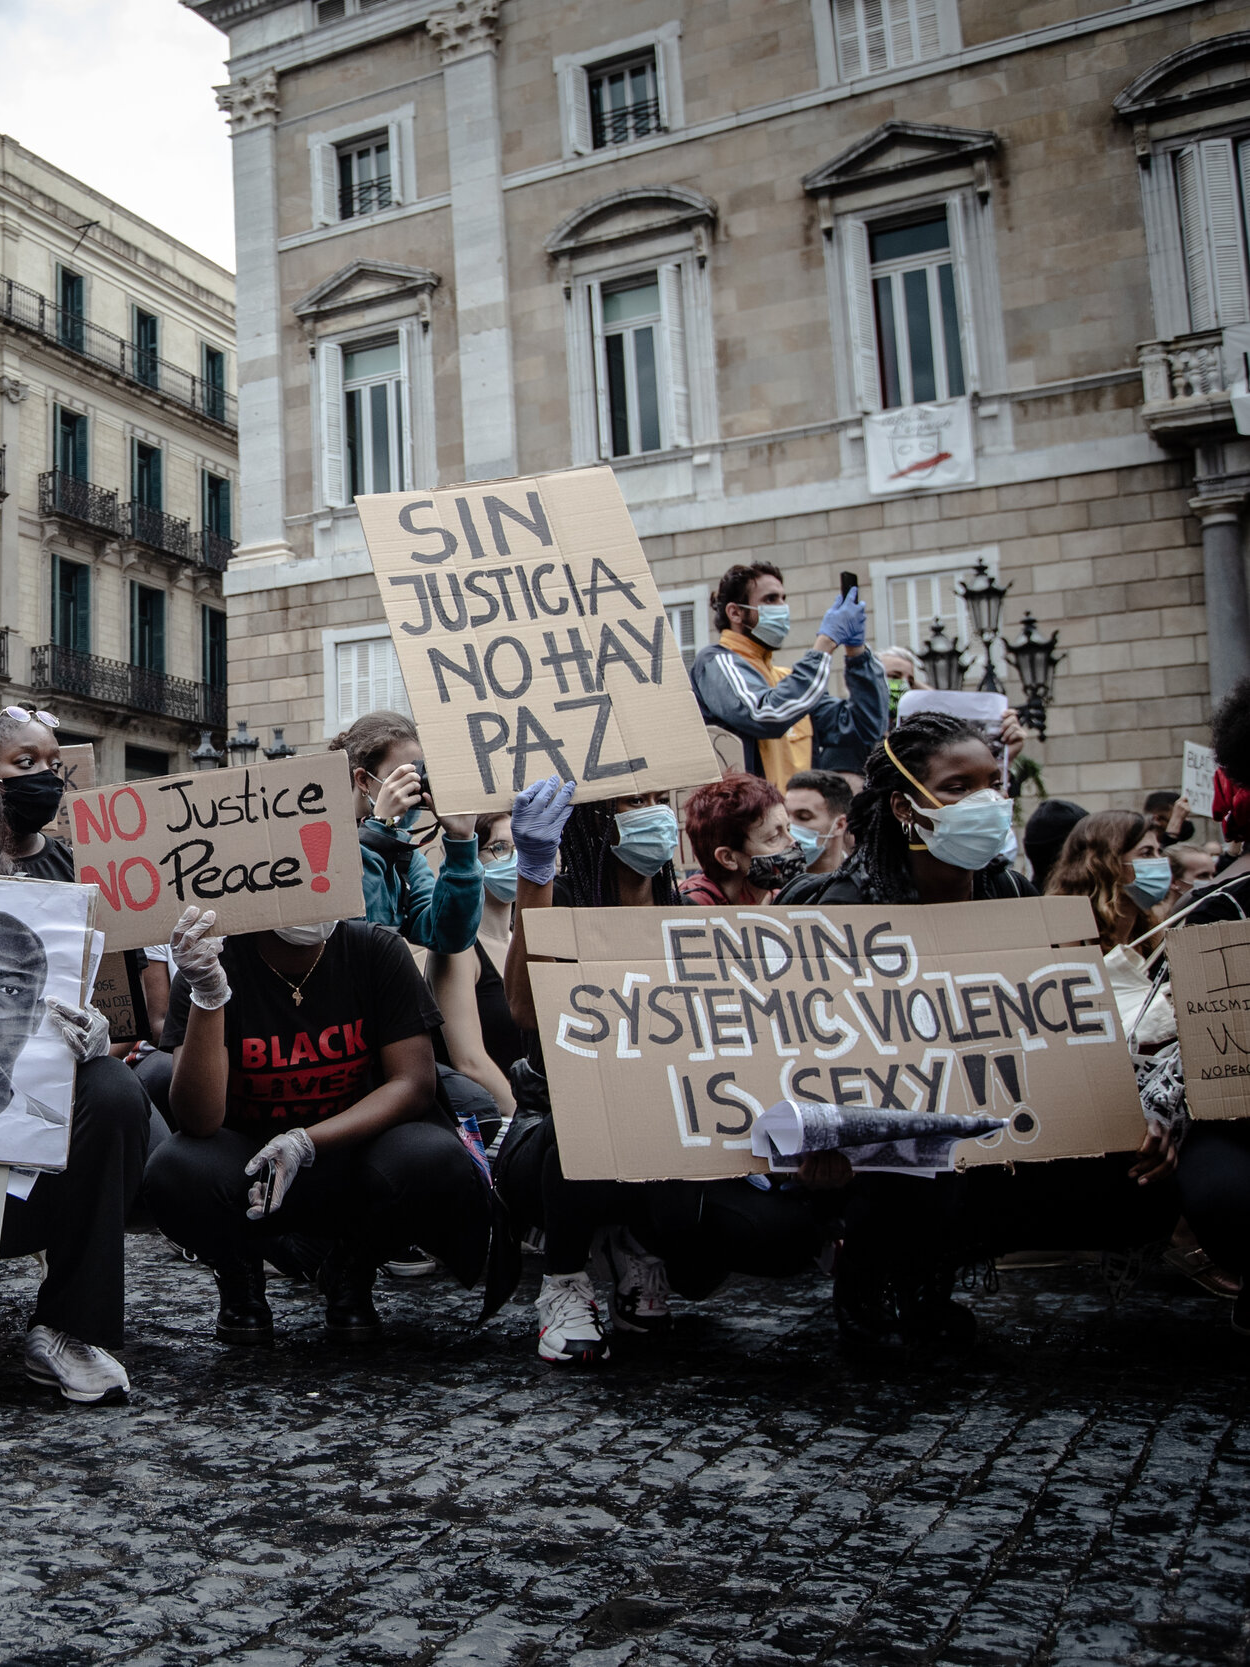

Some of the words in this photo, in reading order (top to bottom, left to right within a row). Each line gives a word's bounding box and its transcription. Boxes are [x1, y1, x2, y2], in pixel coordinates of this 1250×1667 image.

[398, 491, 553, 564] SIN
[388, 557, 646, 635] JUSTICIA
[427, 635, 532, 703] NO
[540, 616, 664, 694] HAY
[466, 694, 648, 795] PAZ
[72, 787, 146, 844] NO
[158, 769, 327, 833] Justice
[80, 856, 160, 912] NO
[665, 915, 915, 985] ENDING
[113, 995, 132, 1007] DIE
[563, 980, 852, 1053] SYSTEMIC
[853, 971, 1110, 1048] VIOLENCE
[242, 1019, 367, 1069] BLACK
[243, 1065, 366, 1098] LIVES
[676, 1068, 755, 1138] IS
